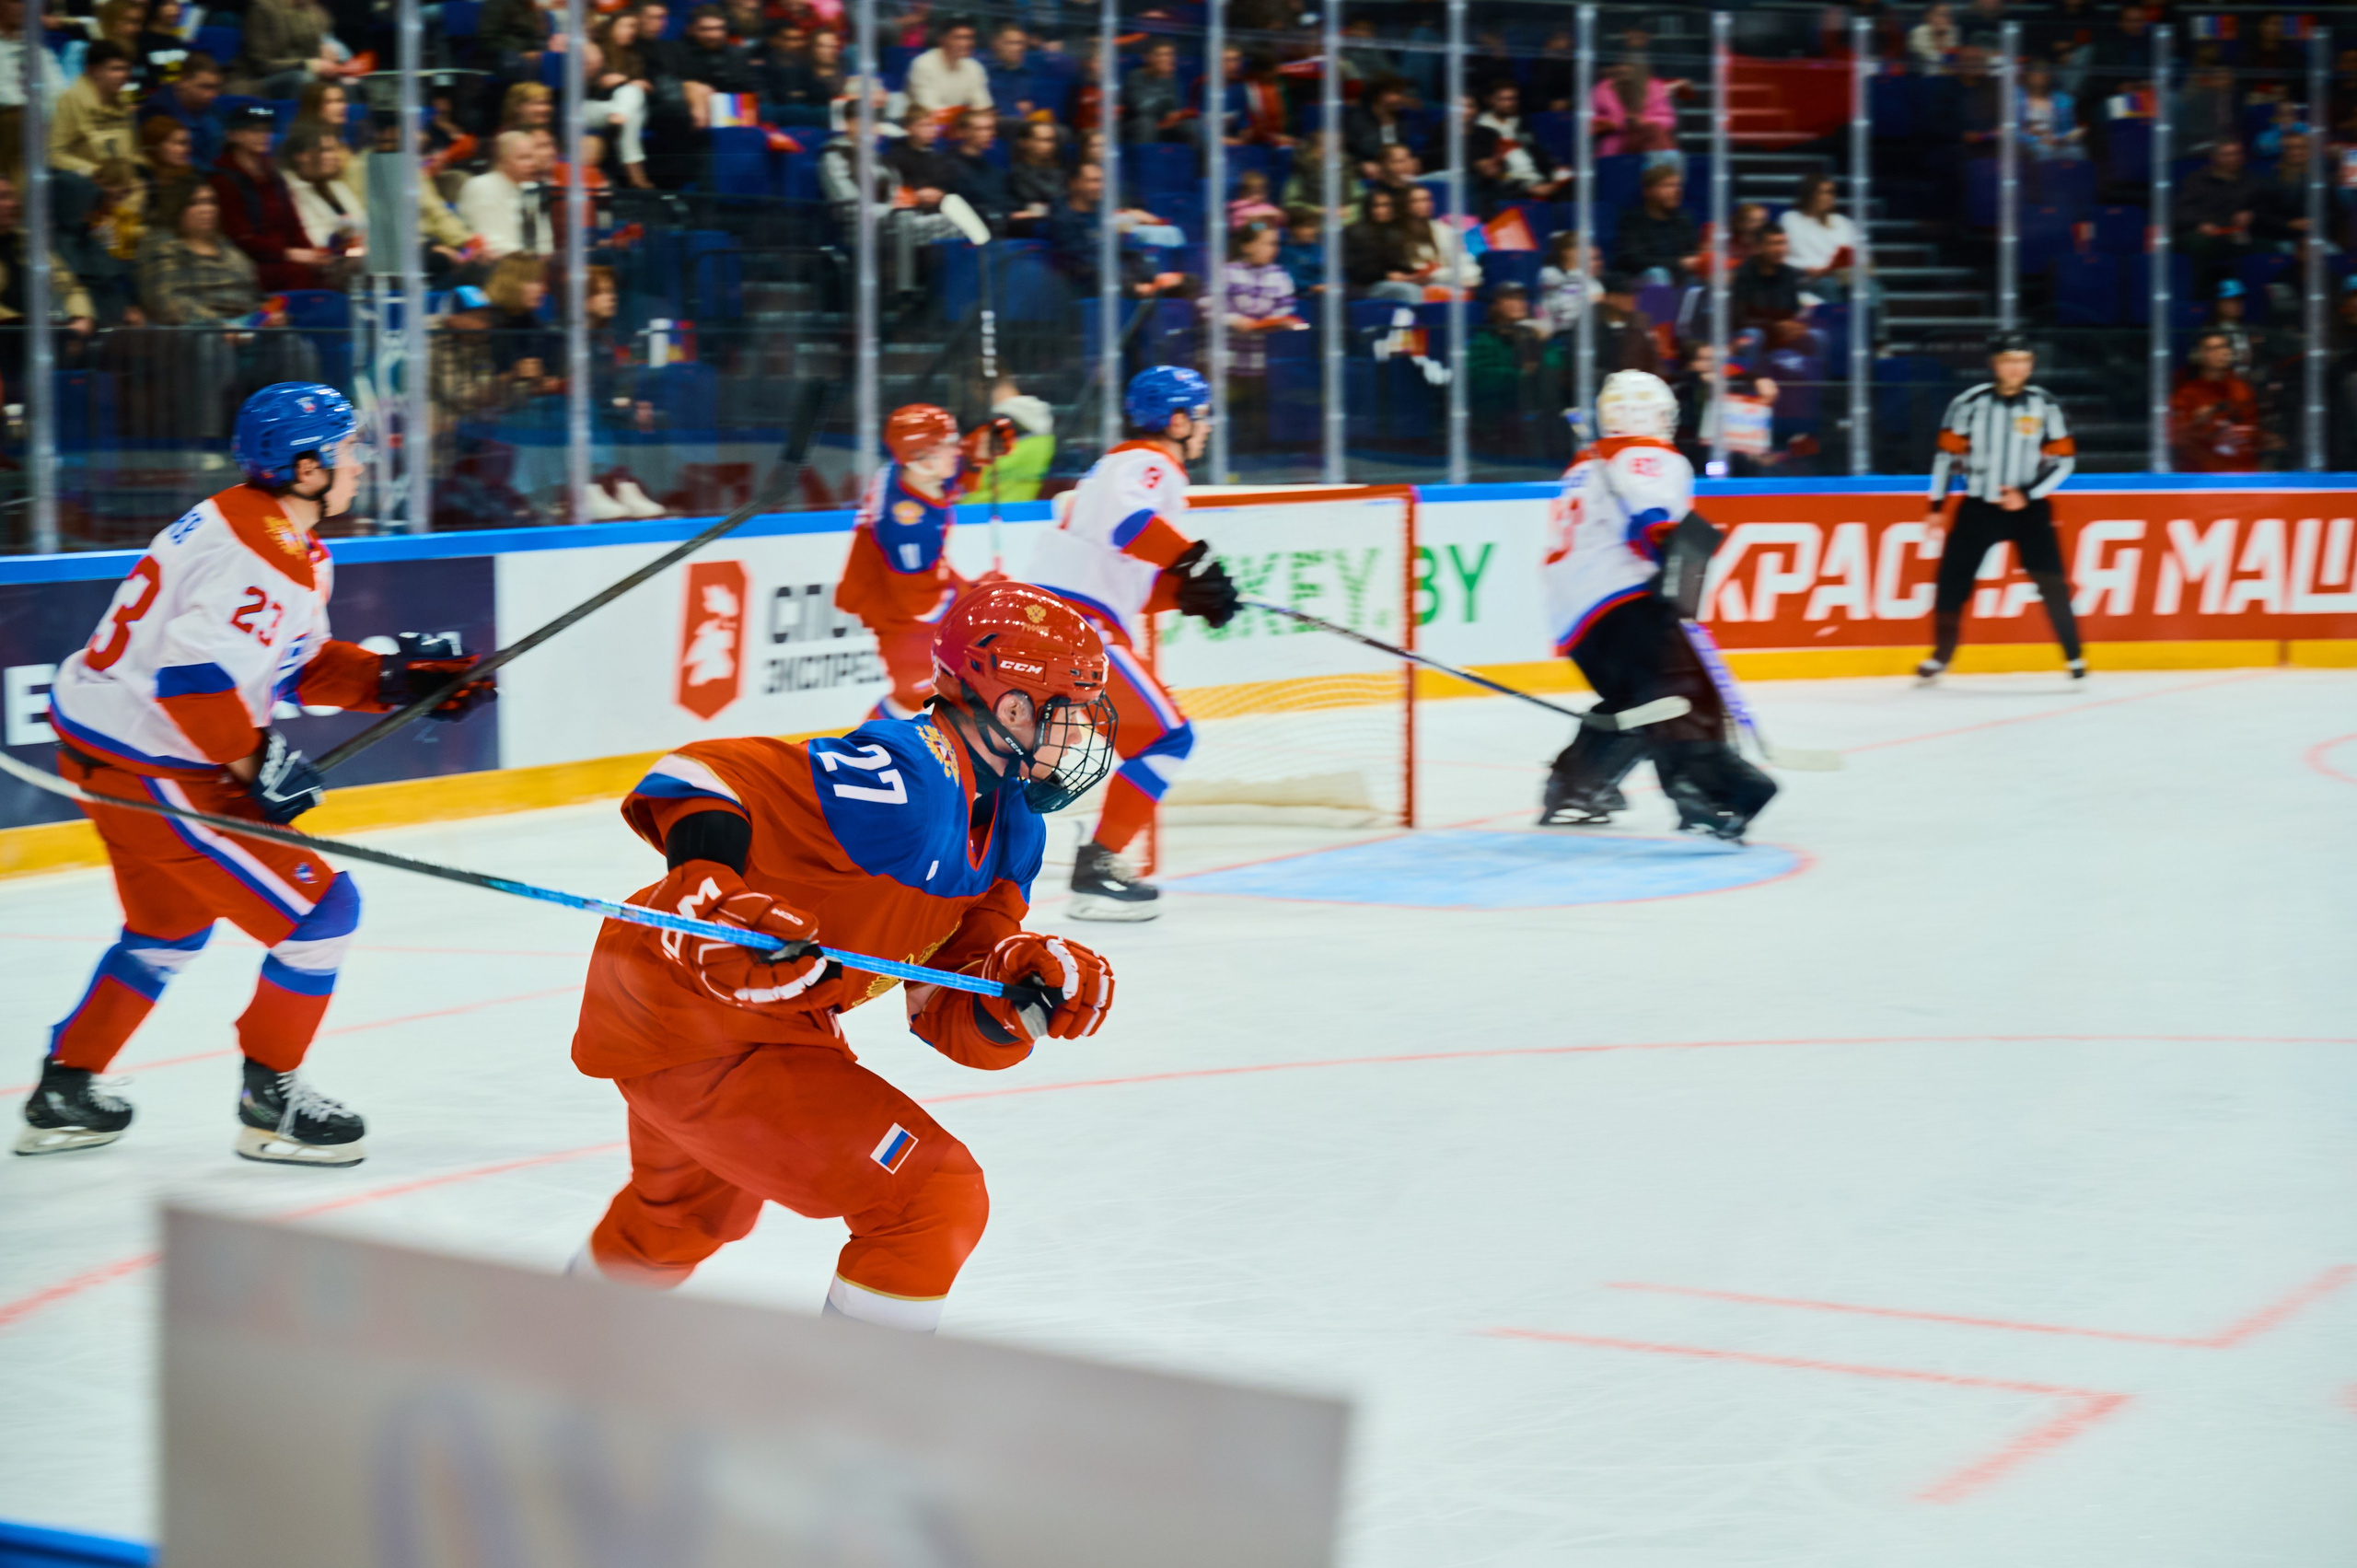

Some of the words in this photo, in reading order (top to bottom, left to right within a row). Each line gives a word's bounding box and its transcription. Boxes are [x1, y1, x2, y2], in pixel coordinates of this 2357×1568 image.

[227, 585, 285, 647] 23
[1000, 660, 1043, 674] CCM
[1004, 737, 1025, 756] CCM
[816, 743, 908, 805] 27
